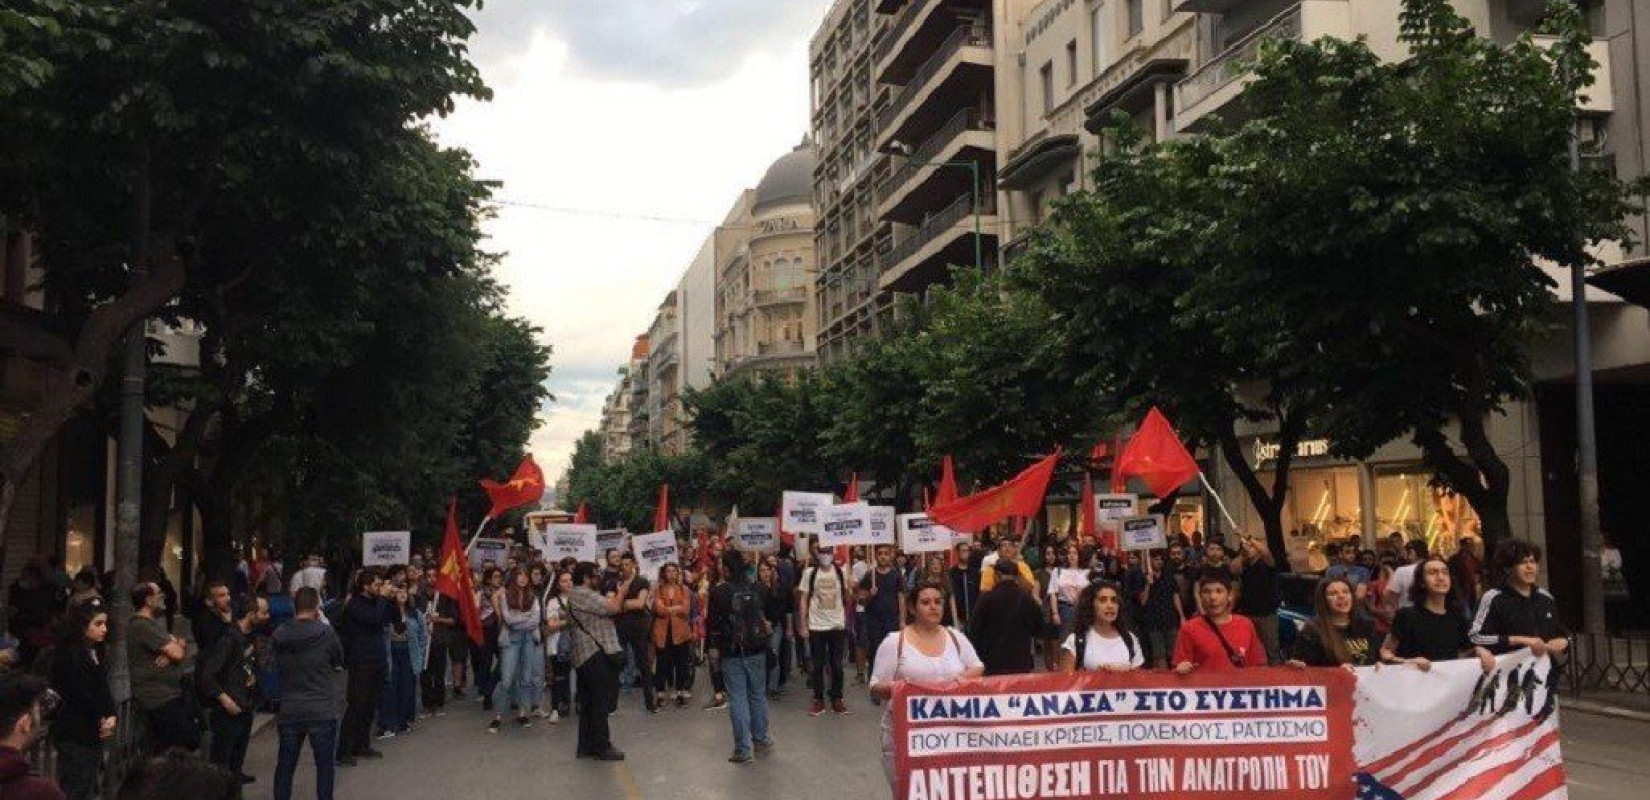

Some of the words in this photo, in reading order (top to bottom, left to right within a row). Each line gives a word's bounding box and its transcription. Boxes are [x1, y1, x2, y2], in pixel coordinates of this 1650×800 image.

[910, 697, 1001, 719] ΚΑΜΙΑ
[1133, 691, 1186, 711] ΣΤΟ
[1195, 688, 1323, 710] ΣΥΣΤΗΜΑ
[911, 733, 951, 750] ΠΟΥ
[956, 730, 1040, 748] ΓΕΝΝΑΕΙ
[1044, 724, 1112, 744] ΚΡΙΣΕΙΣ,
[1118, 721, 1228, 742] ΠΟΛΕΜΟΥΣ,
[1232, 719, 1325, 739] ΡΑΤΣΙΣΜΟ
[908, 761, 1091, 800] ΑΝΤΕΠΙΘΕΣΗ
[1098, 759, 1128, 795] ΓΙΑ
[1135, 757, 1175, 793] ΤΗΝ
[1182, 755, 1288, 791] ΑΝΑΤΡΟΠΗ
[1294, 752, 1330, 790] ΤΟΥ
